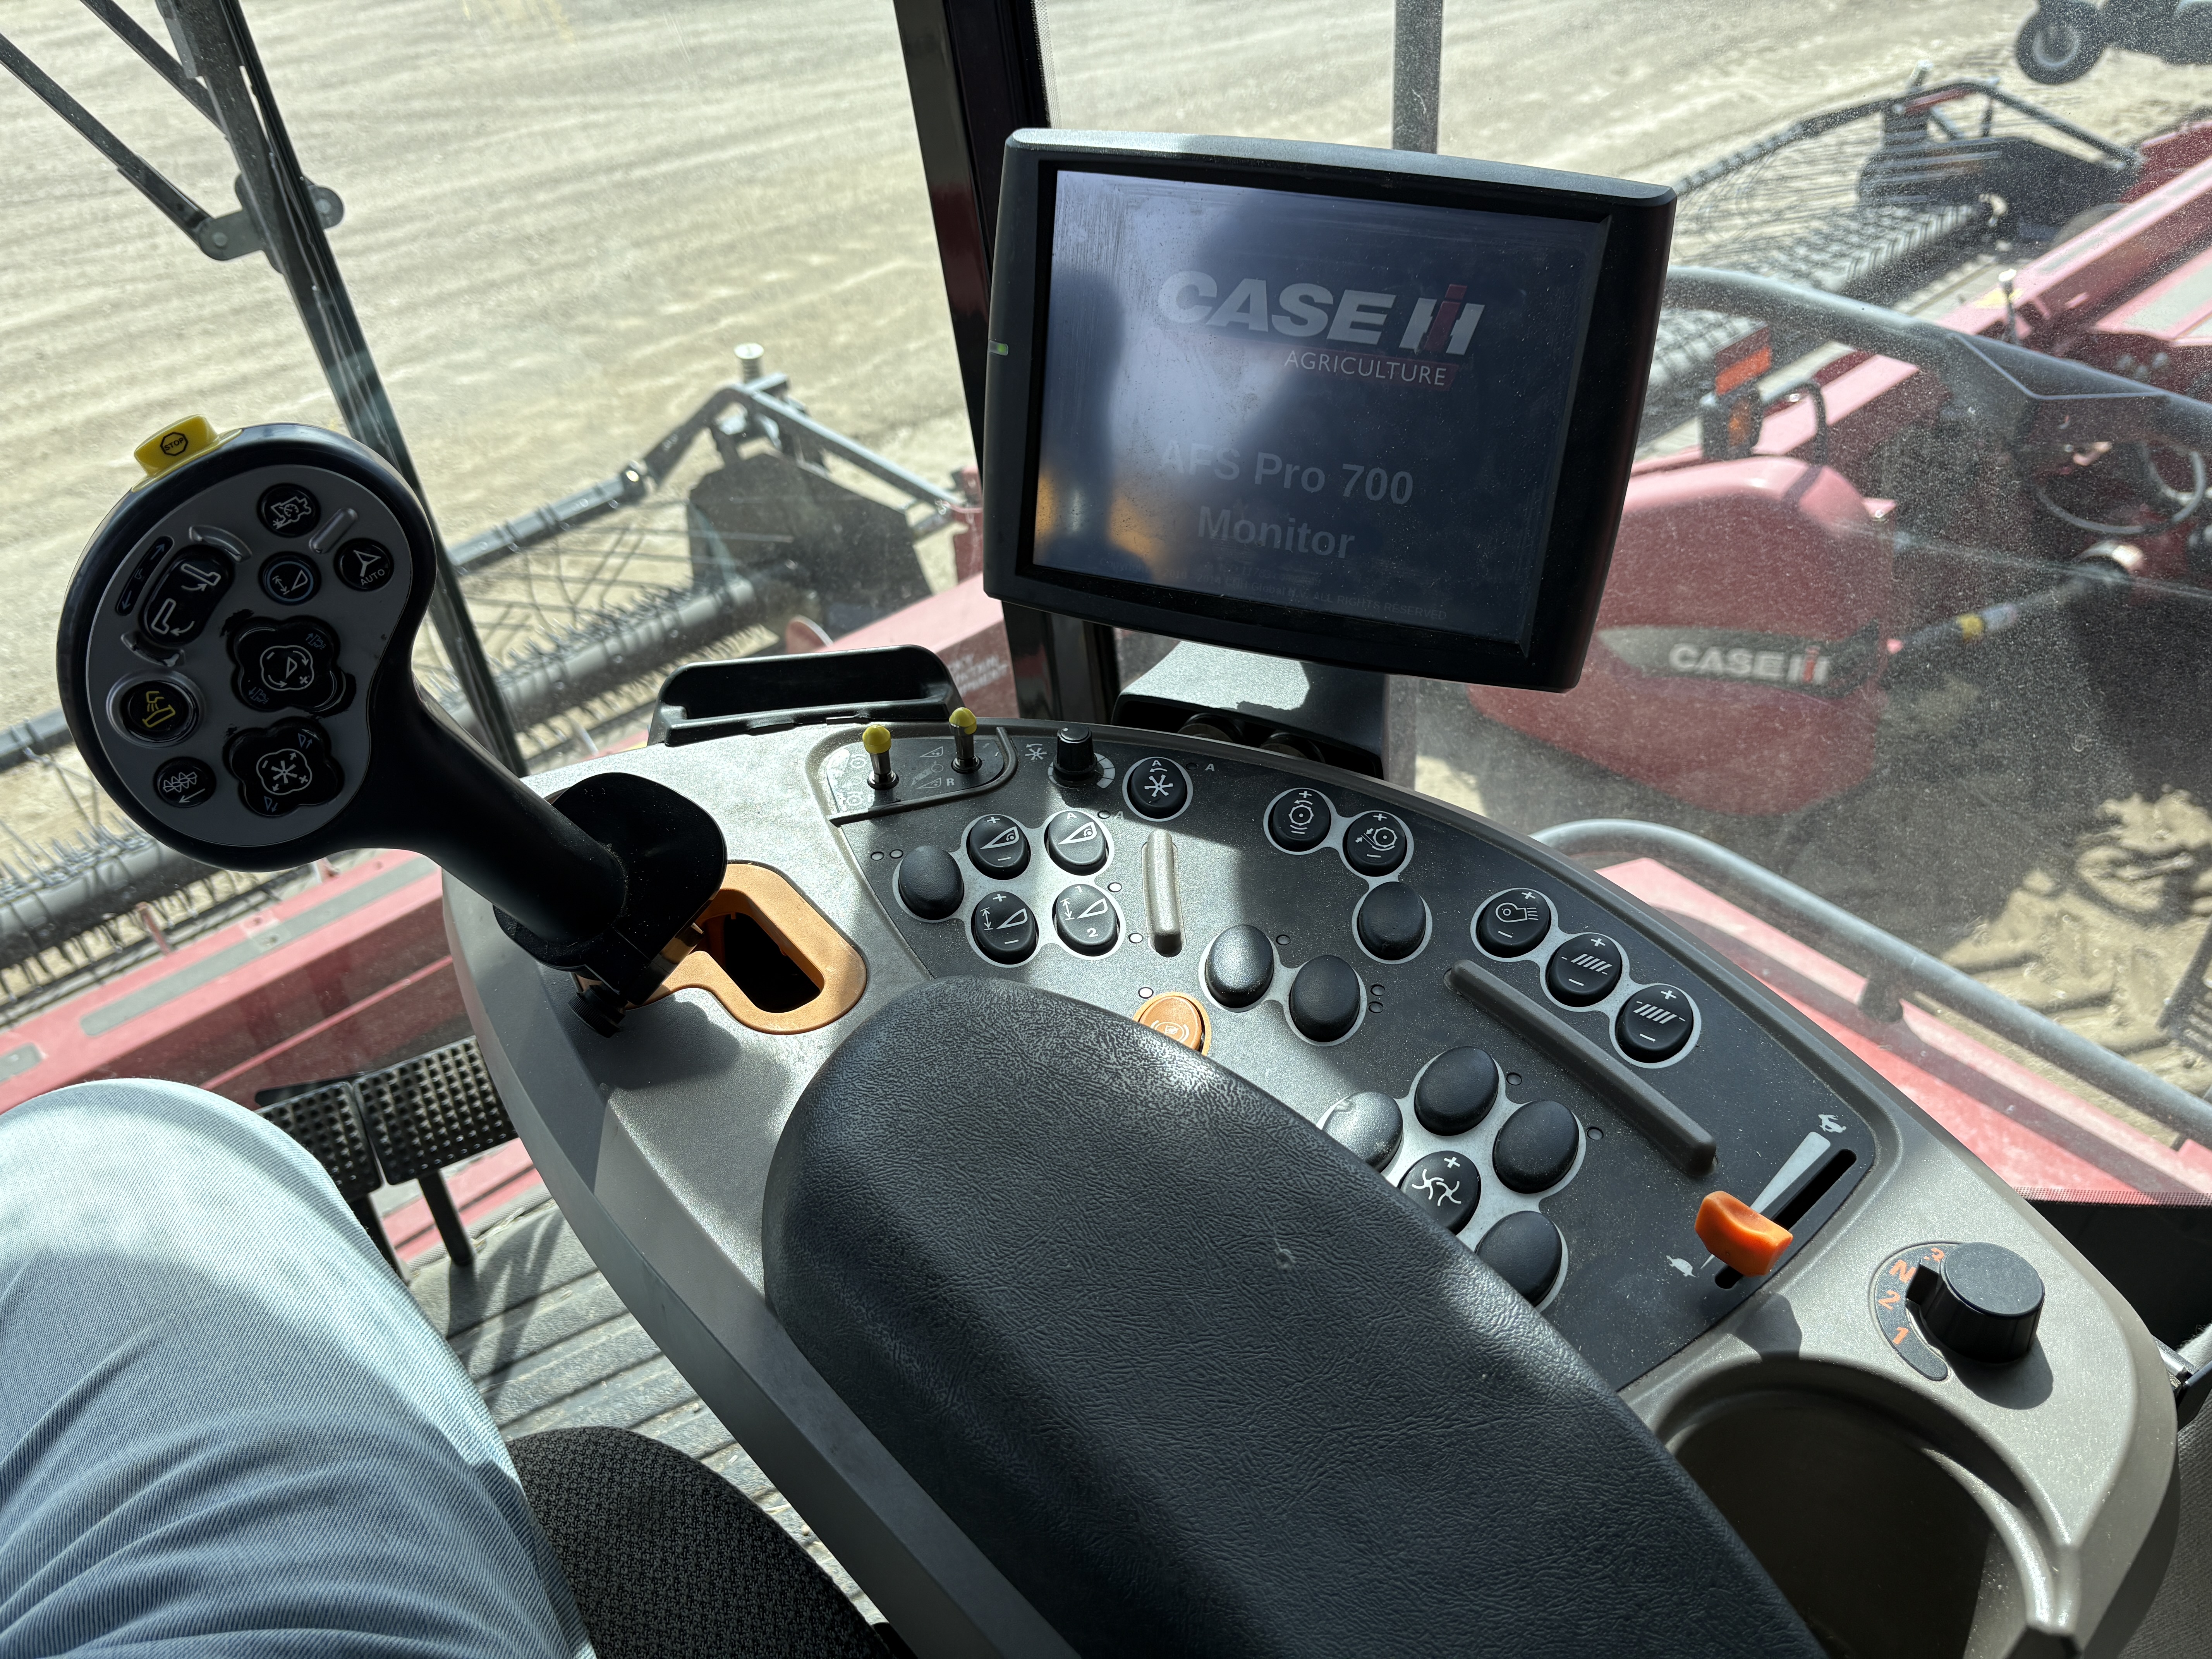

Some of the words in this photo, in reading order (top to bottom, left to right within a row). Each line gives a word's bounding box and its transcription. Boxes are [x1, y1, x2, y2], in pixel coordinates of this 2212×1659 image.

[1158, 270, 1396, 345] CASE
[1284, 350, 1447, 386] AGRICULTURE
[164, 437, 184, 451] STOP
[1161, 439, 1241, 481] AFS
[1254, 451, 1326, 494] Pro
[1341, 463, 1414, 505] 700
[1197, 505, 1356, 559] Monitor
[361, 569, 385, 586] AUTO
[1251, 581, 1285, 596] Global
[1314, 593, 1333, 603] ALL
[1337, 595, 1381, 610] RIGHTS
[1384, 603, 1447, 620] RESERVED
[1668, 643, 1785, 680] CASE
[1205, 763, 1215, 772] A
[946, 778, 955, 786] R
[1113, 811, 1124, 819] A
[1074, 885, 1083, 893] 1
[1087, 927, 1099, 938] 2
[1877, 1290, 1901, 1310] 2
[1893, 1327, 1909, 1345] 1
